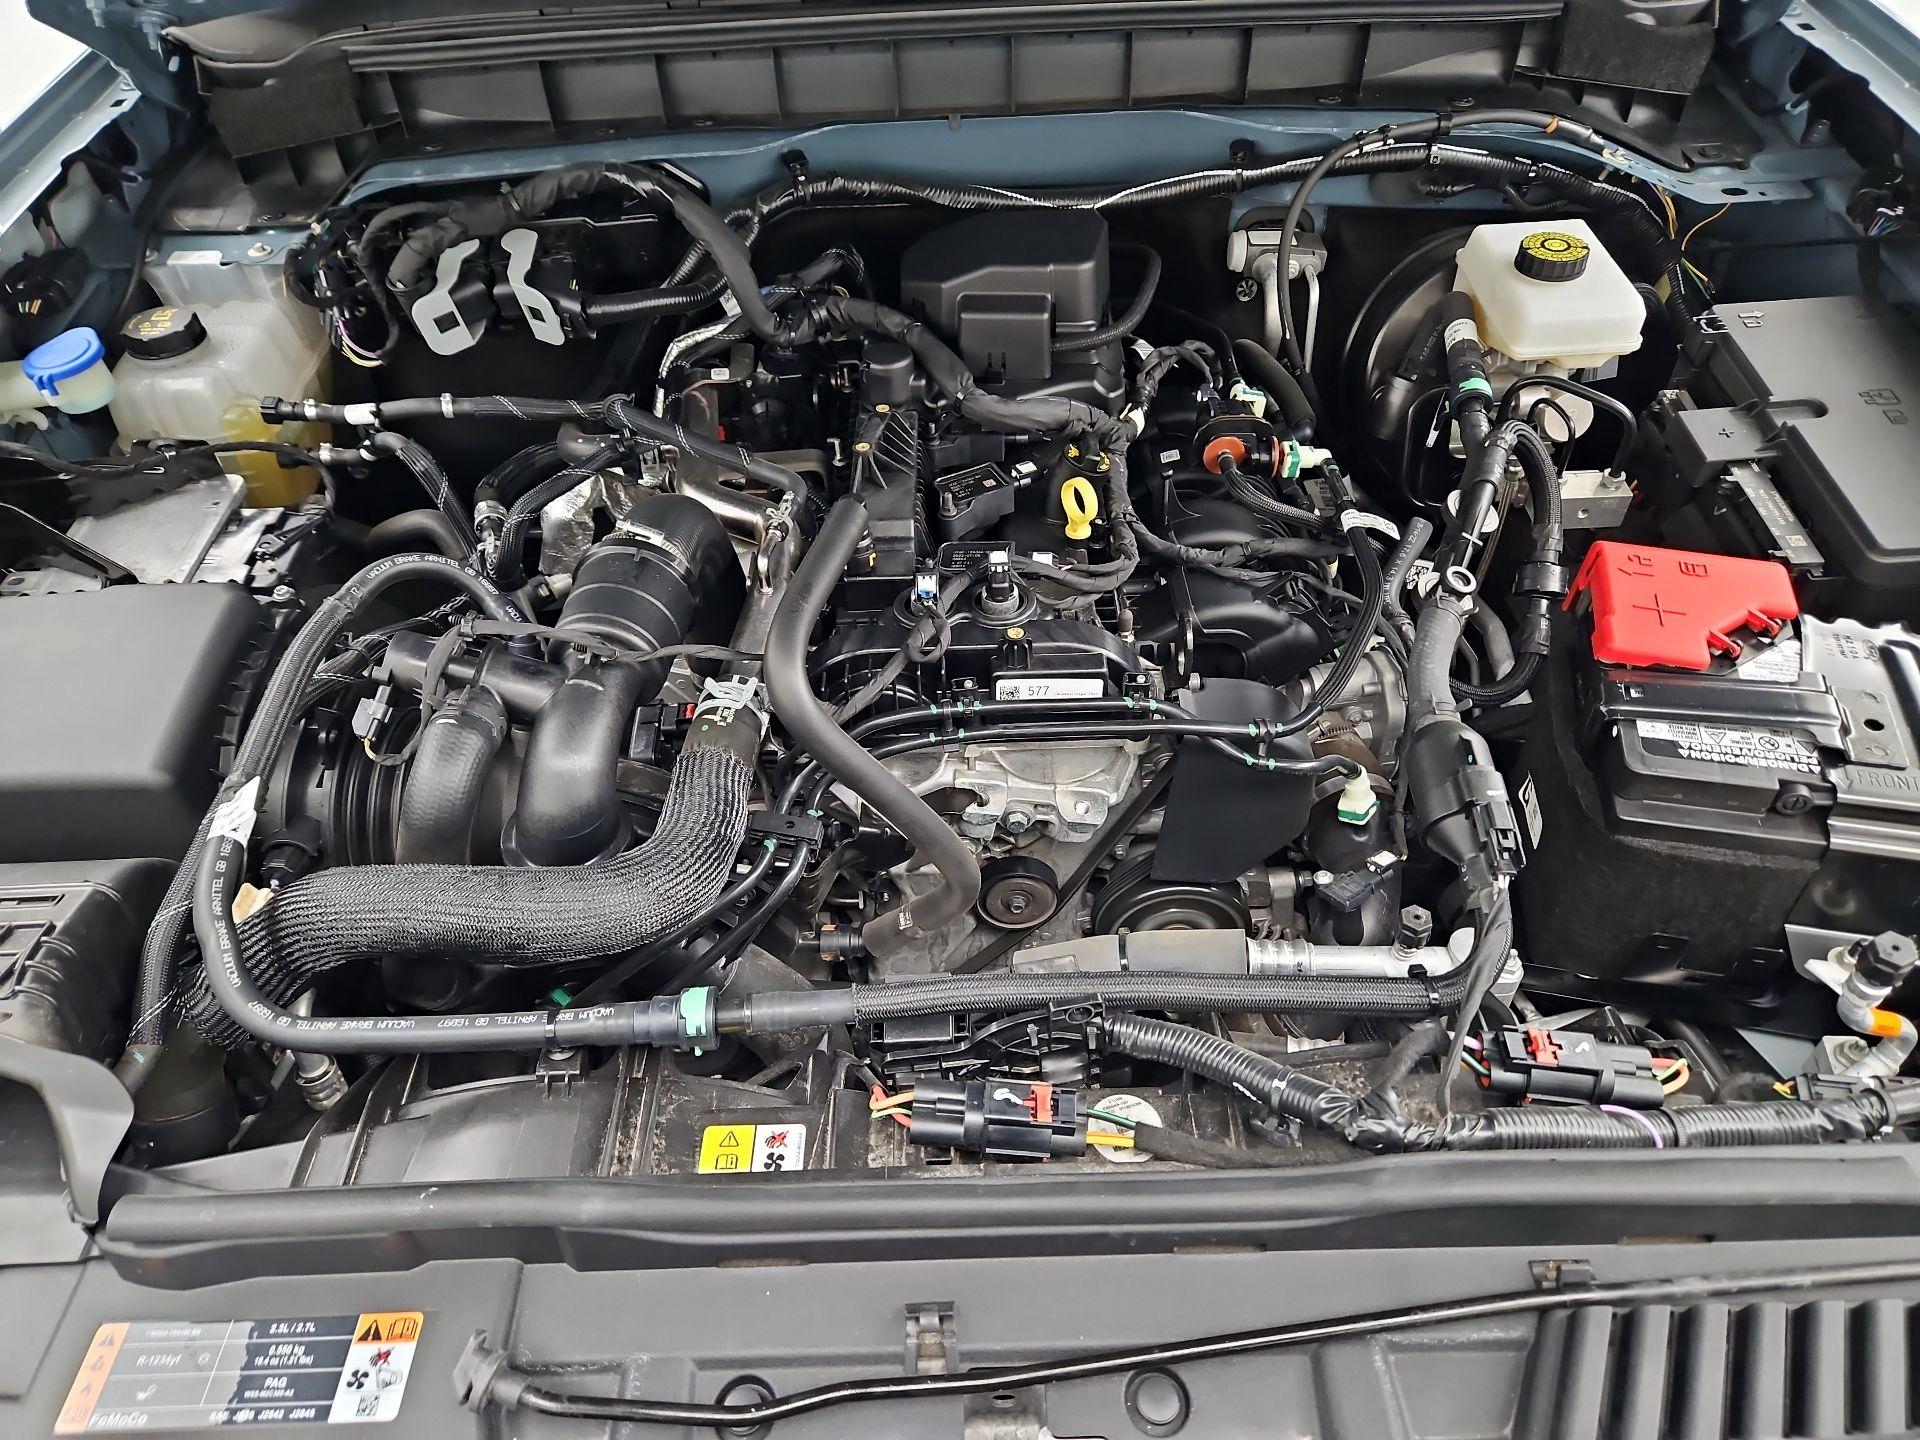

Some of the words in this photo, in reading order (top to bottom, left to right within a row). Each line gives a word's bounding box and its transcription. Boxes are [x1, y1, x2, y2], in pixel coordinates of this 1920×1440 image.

[366, 561, 393, 579] VACUUM
[394, 554, 421, 566] BRAKE
[424, 554, 461, 569] ARNITEL
[464, 566, 477, 577] GB
[505, 605, 523, 624] VACU
[1028, 686, 1050, 697] 577
[1689, 742, 1818, 764] PELIGRO/VENENO
[1690, 749, 1809, 773] DANGER/POISON
[1857, 768, 1920, 792] FRONT
[215, 860, 227, 872] GB
[212, 876, 224, 915] ARNITEL
[214, 919, 232, 950] BRAKE
[222, 952, 242, 988] VACUUM
[276, 1016, 292, 1027] GB
[475, 1017, 490, 1026] GB
[495, 1015, 538, 1025] ARNITEL
[541, 1011, 574, 1023] BRAE
[578, 1007, 615, 1022] VACUUM
[296, 1019, 338, 1030] ARNITEL
[339, 1020, 374, 1030] BRAKE
[377, 1020, 416, 1029] VACUUM
[264, 1376, 288, 1389] PAG
[88, 1411, 149, 1428] FoMoCo
